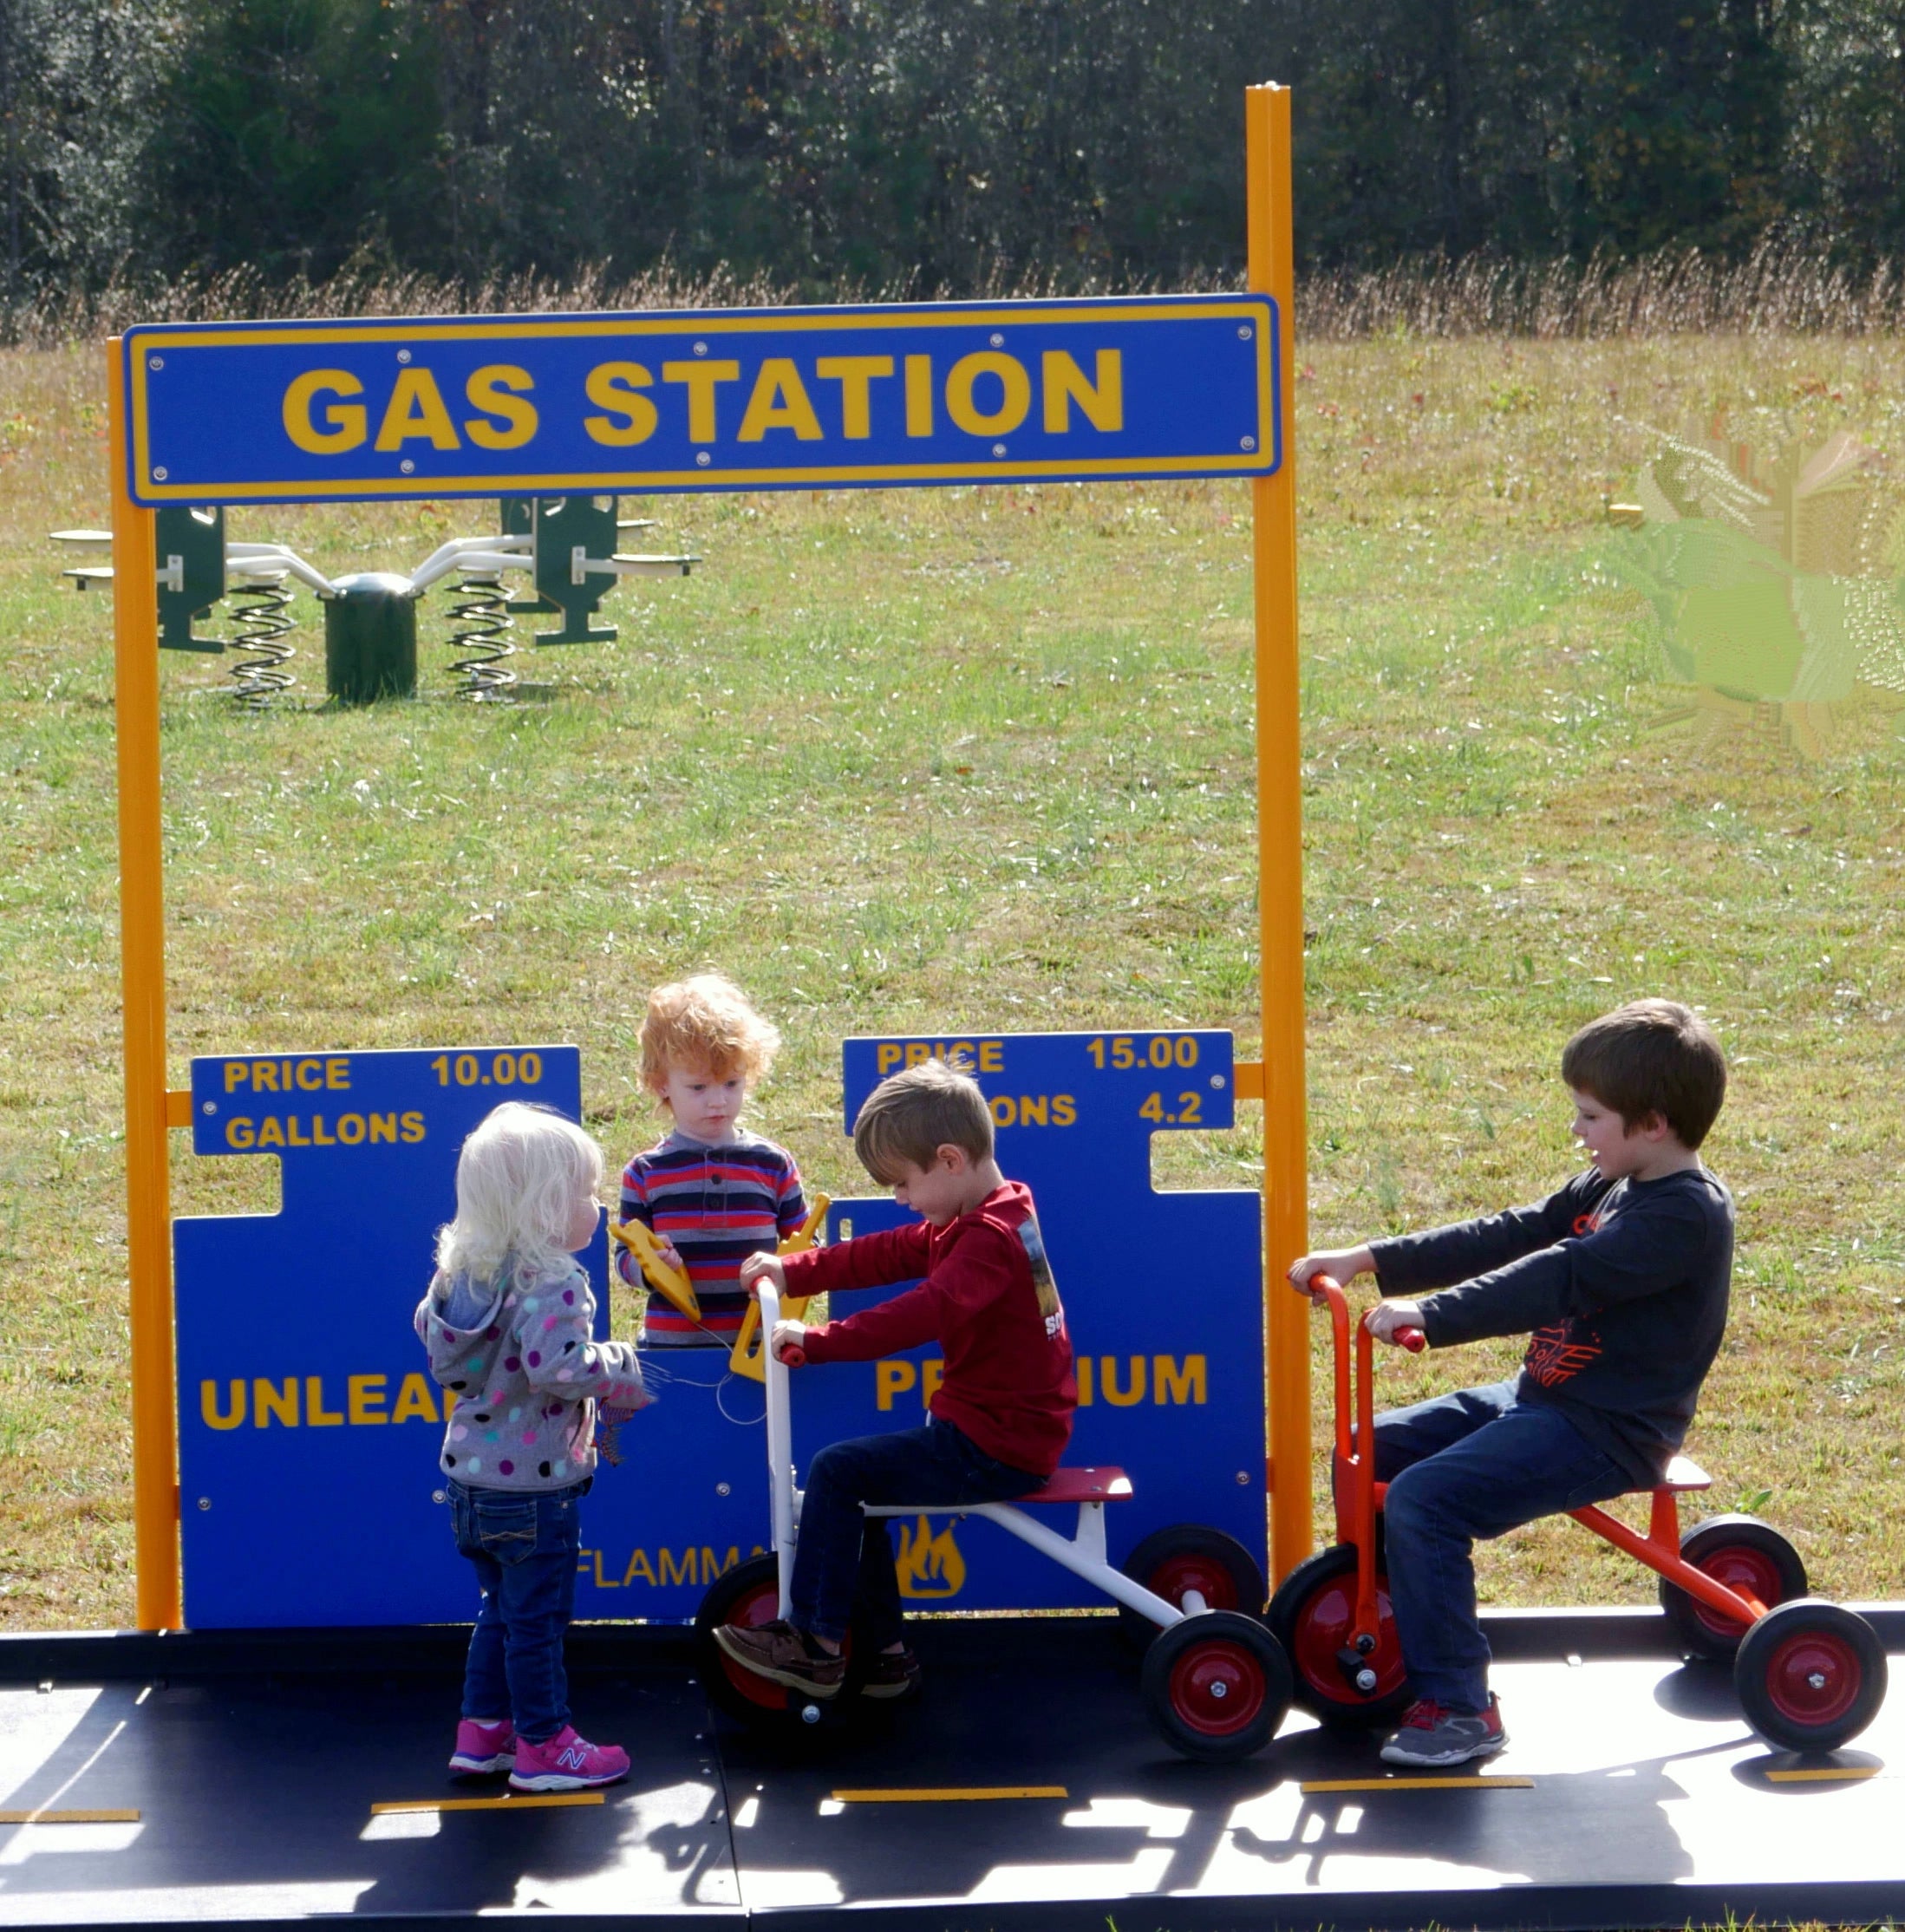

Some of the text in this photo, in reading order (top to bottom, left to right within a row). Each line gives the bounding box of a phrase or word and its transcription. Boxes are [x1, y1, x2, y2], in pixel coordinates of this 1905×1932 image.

[282, 348, 1124, 455] GAS STATION
[223, 1051, 543, 1093] PRICE 10.00
[877, 1035, 1199, 1075] PRICE 15.00
[1138, 1091, 1203, 1124] 4.2
[225, 1110, 427, 1150] GALLONS
